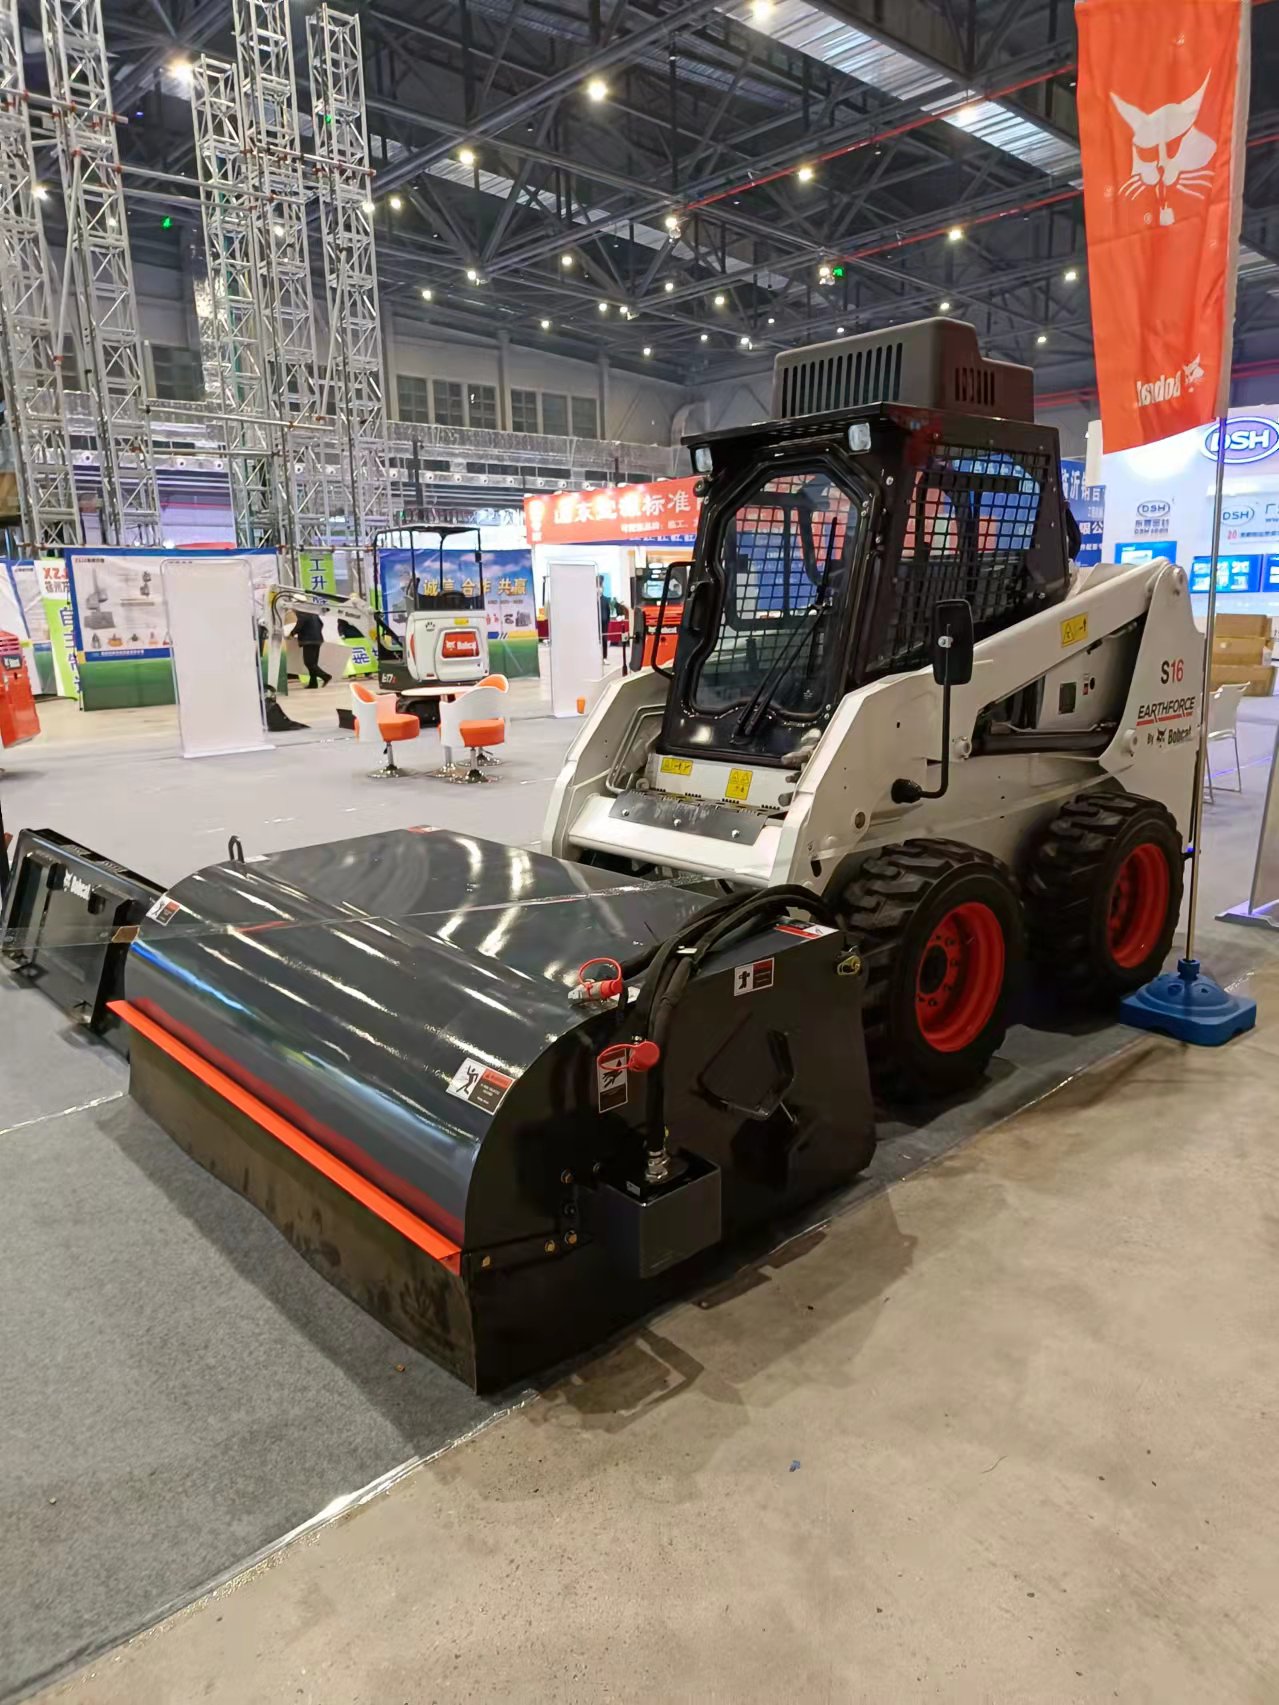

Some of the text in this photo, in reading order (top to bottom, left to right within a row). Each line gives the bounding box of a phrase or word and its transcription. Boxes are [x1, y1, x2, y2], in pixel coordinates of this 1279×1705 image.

[1210, 429, 1270, 452] DSH
[1142, 504, 1166, 512] DSH
[1223, 511, 1249, 520] DSH
[1161, 659, 1184, 684] S16
[1137, 696, 1196, 723] EARTHFORCE
